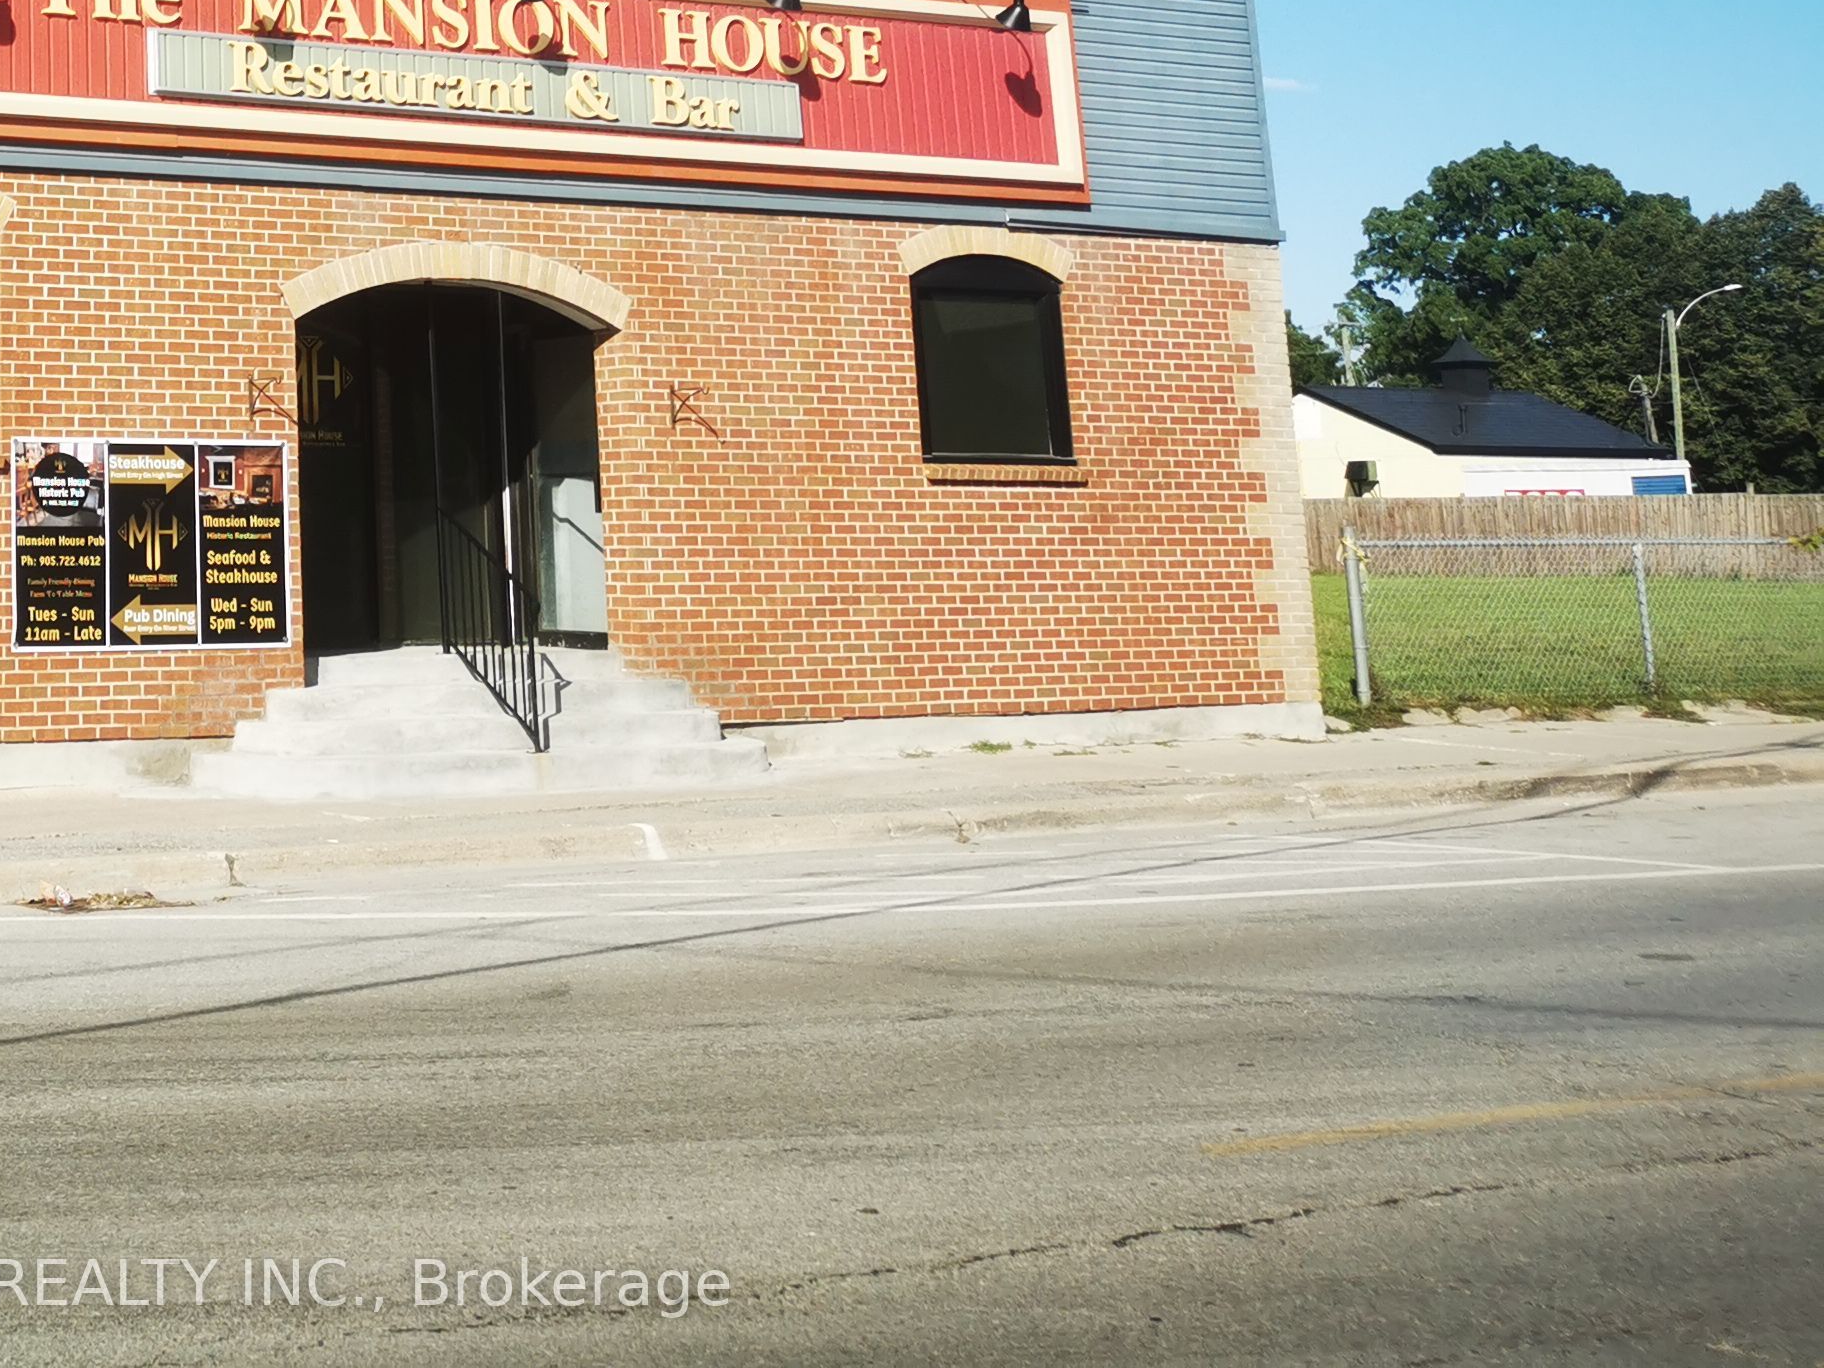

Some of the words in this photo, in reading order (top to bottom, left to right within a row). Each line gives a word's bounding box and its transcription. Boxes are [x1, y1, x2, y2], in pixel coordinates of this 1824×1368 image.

[658, 7, 888, 85] HOUSE
[228, 40, 534, 114] Restaurant
[564, 69, 620, 122] &
[646, 75, 740, 131] Bar
[109, 455, 185, 469] Steakhouse
[70, 487, 85, 497] Pub
[203, 514, 247, 527] Mansion
[250, 514, 281, 527] House
[17, 535, 56, 546] Mansion
[58, 535, 85, 546] House
[88, 535, 105, 546] Pub
[20, 555, 37, 566] Ph:
[39, 555, 101, 566] 905.722.4612
[207, 549, 256, 565] Seafood
[260, 549, 272, 565] &
[206, 568, 278, 584] Steakhouse
[211, 597, 237, 612] Wed
[250, 597, 273, 612] Sun
[28, 606, 57, 621] Tues
[71, 606, 95, 621] Sun
[124, 608, 150, 623] Pub
[153, 608, 195, 625] Dining
[209, 615, 236, 634] 5pm
[249, 615, 275, 634] 9pm
[24, 626, 60, 641] 11am
[74, 625, 102, 641] Late
